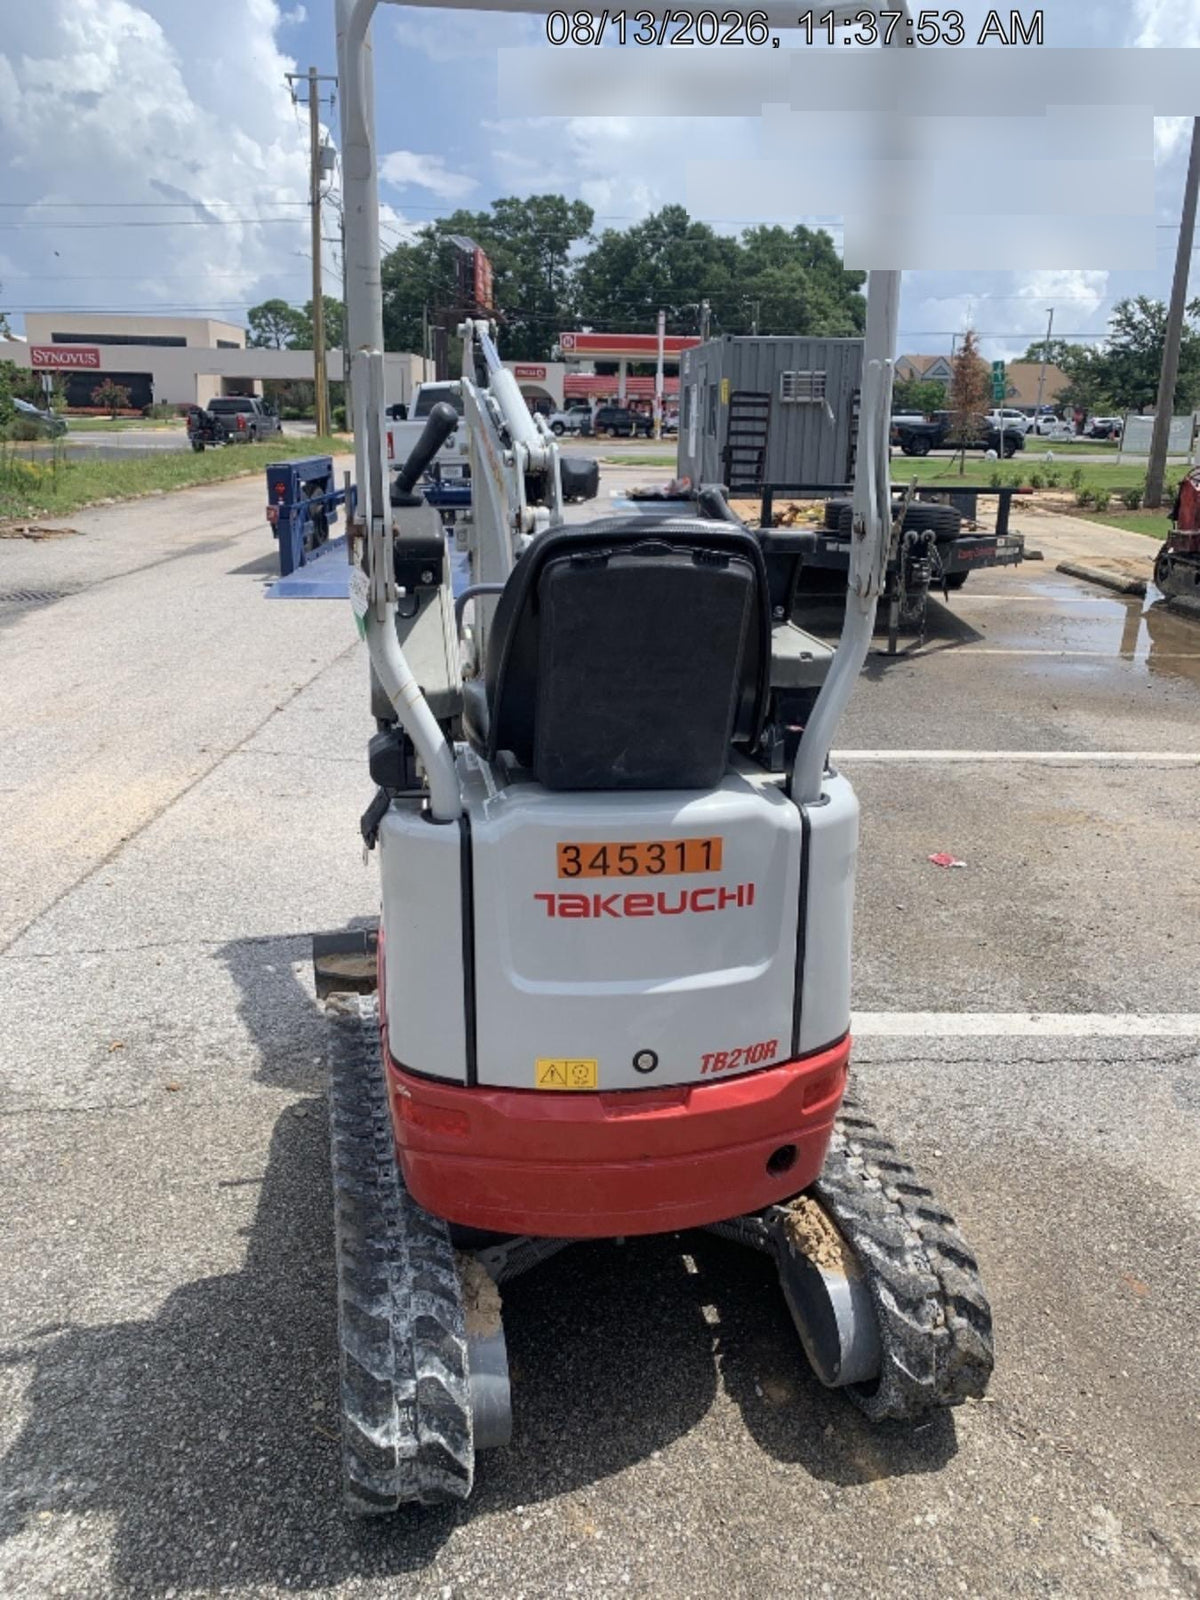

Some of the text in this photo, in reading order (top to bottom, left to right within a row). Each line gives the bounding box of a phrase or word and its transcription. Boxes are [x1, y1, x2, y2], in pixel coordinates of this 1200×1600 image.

[33, 349, 97, 365] SYNOVUS
[561, 840, 713, 877] 345311
[700, 1039, 778, 1075] TB210R
